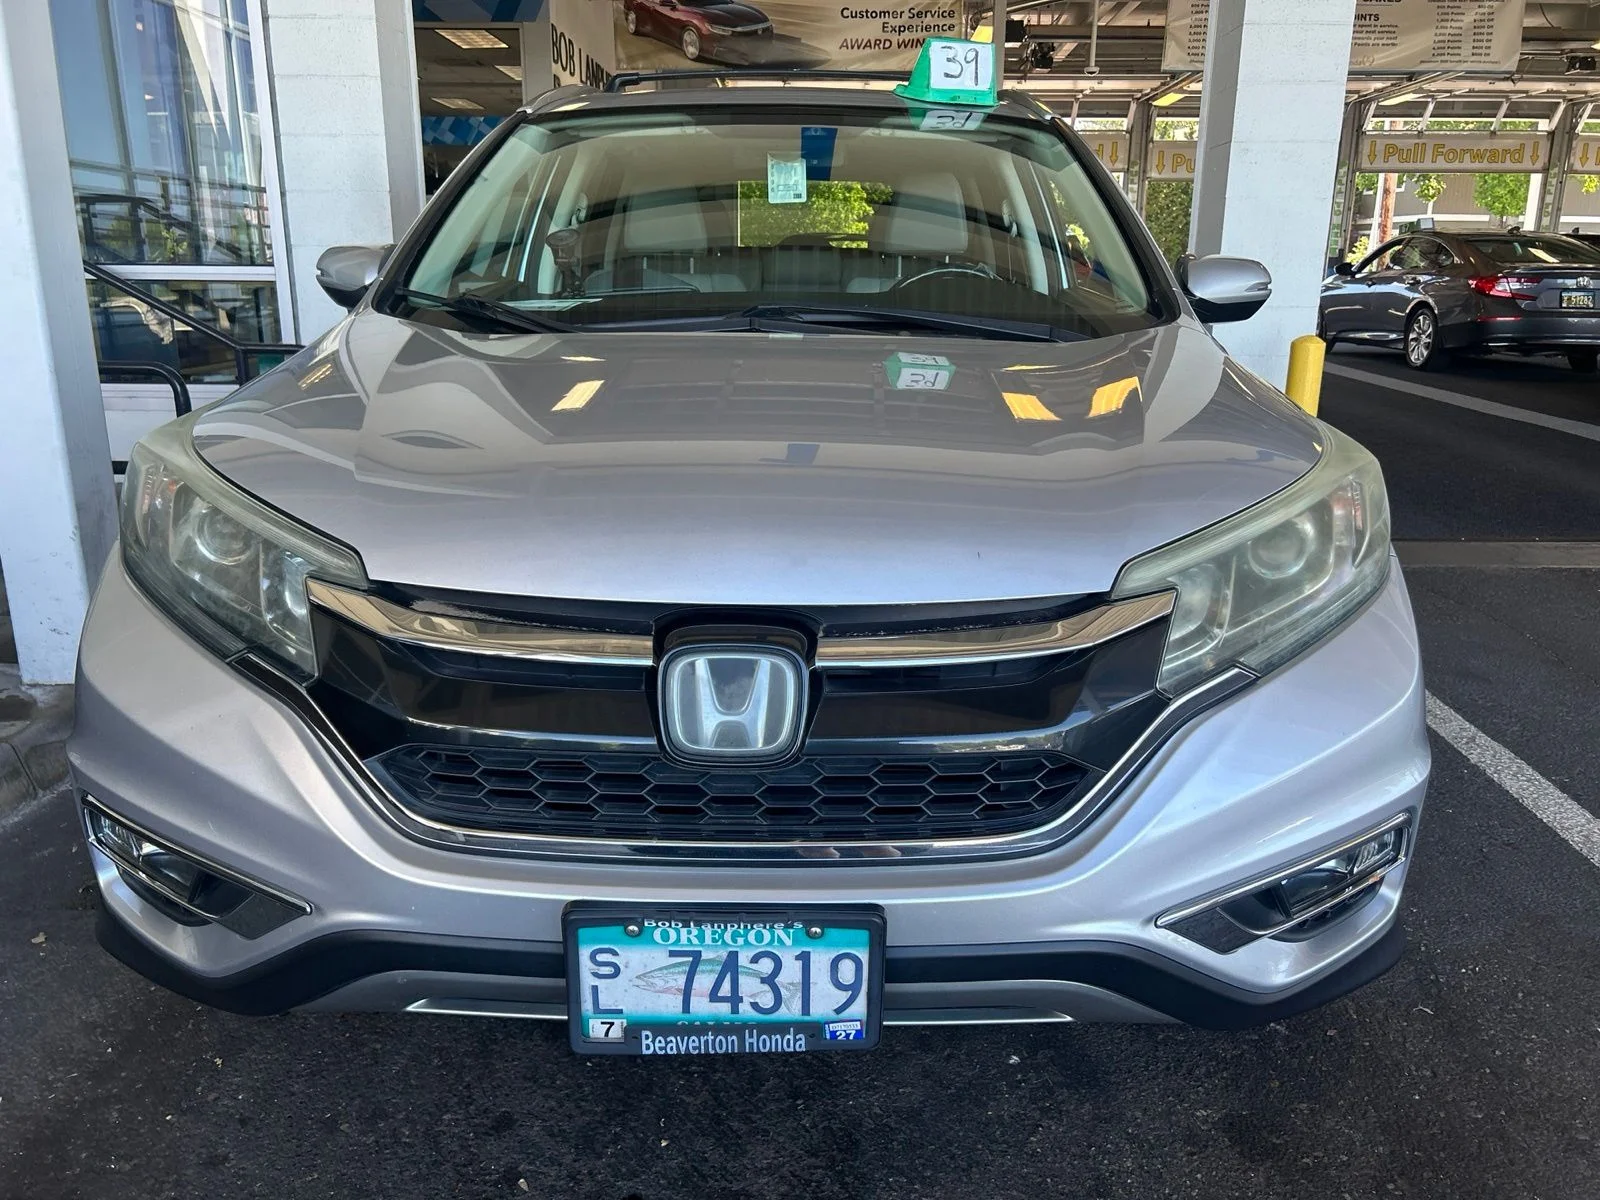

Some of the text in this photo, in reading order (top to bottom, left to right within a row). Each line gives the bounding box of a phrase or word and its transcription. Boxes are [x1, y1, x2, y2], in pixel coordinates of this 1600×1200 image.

[840, 7, 956, 19] Customer Service
[881, 21, 956, 36] Experience
[551, 22, 576, 77] BOB
[839, 37, 926, 50] AWARD WIN
[940, 45, 979, 87] 39
[1383, 143, 1526, 164] Pull Forward
[653, 927, 796, 947] OREGON
[668, 949, 864, 1017] 74319
[600, 1021, 616, 1038] 7
[835, 1029, 857, 1041] 27
[640, 1027, 807, 1056] Beaverton Honda
